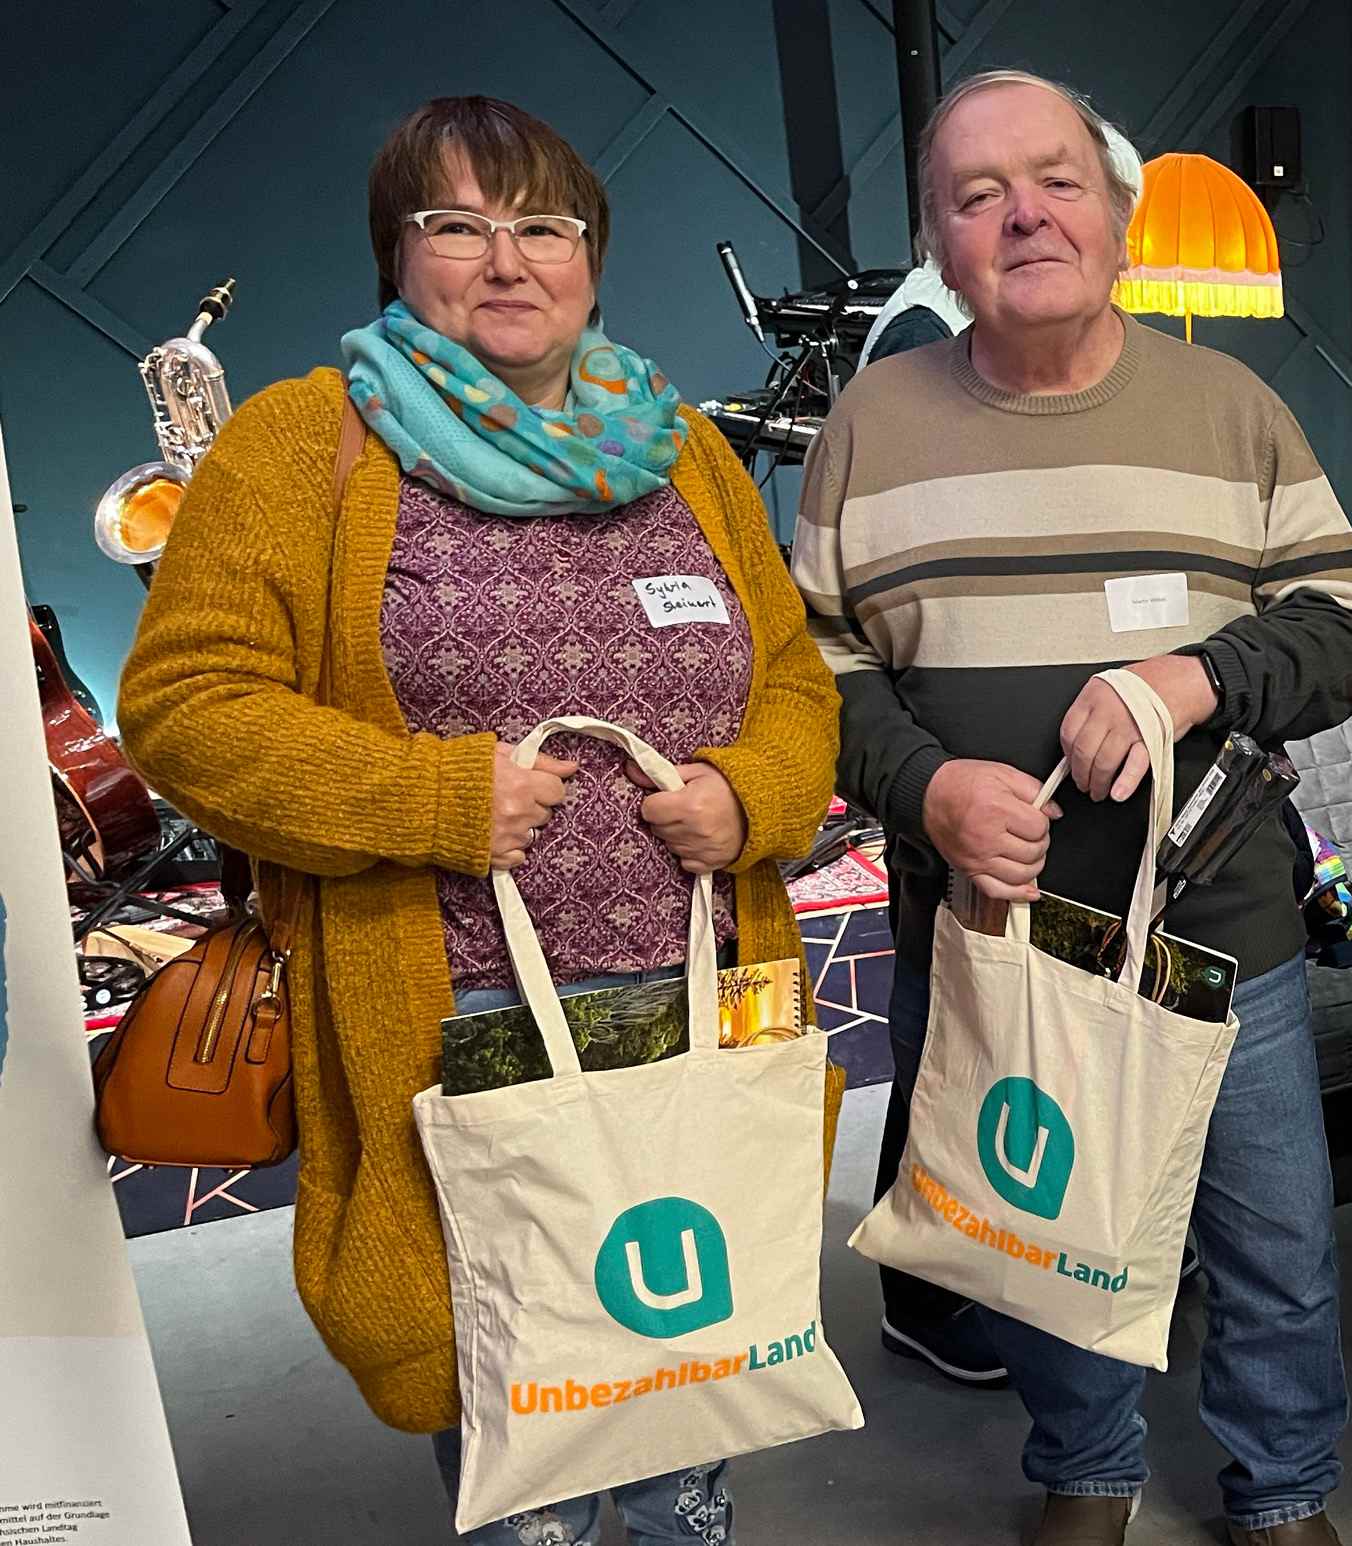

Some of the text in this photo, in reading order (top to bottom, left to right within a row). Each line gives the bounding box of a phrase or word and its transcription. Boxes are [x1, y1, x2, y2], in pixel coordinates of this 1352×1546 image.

[511, 1320, 817, 1415] UnbezahlbarLand
[64, 1511, 110, 1520] Grundlage
[42, 1524, 78, 1533] Landtag
